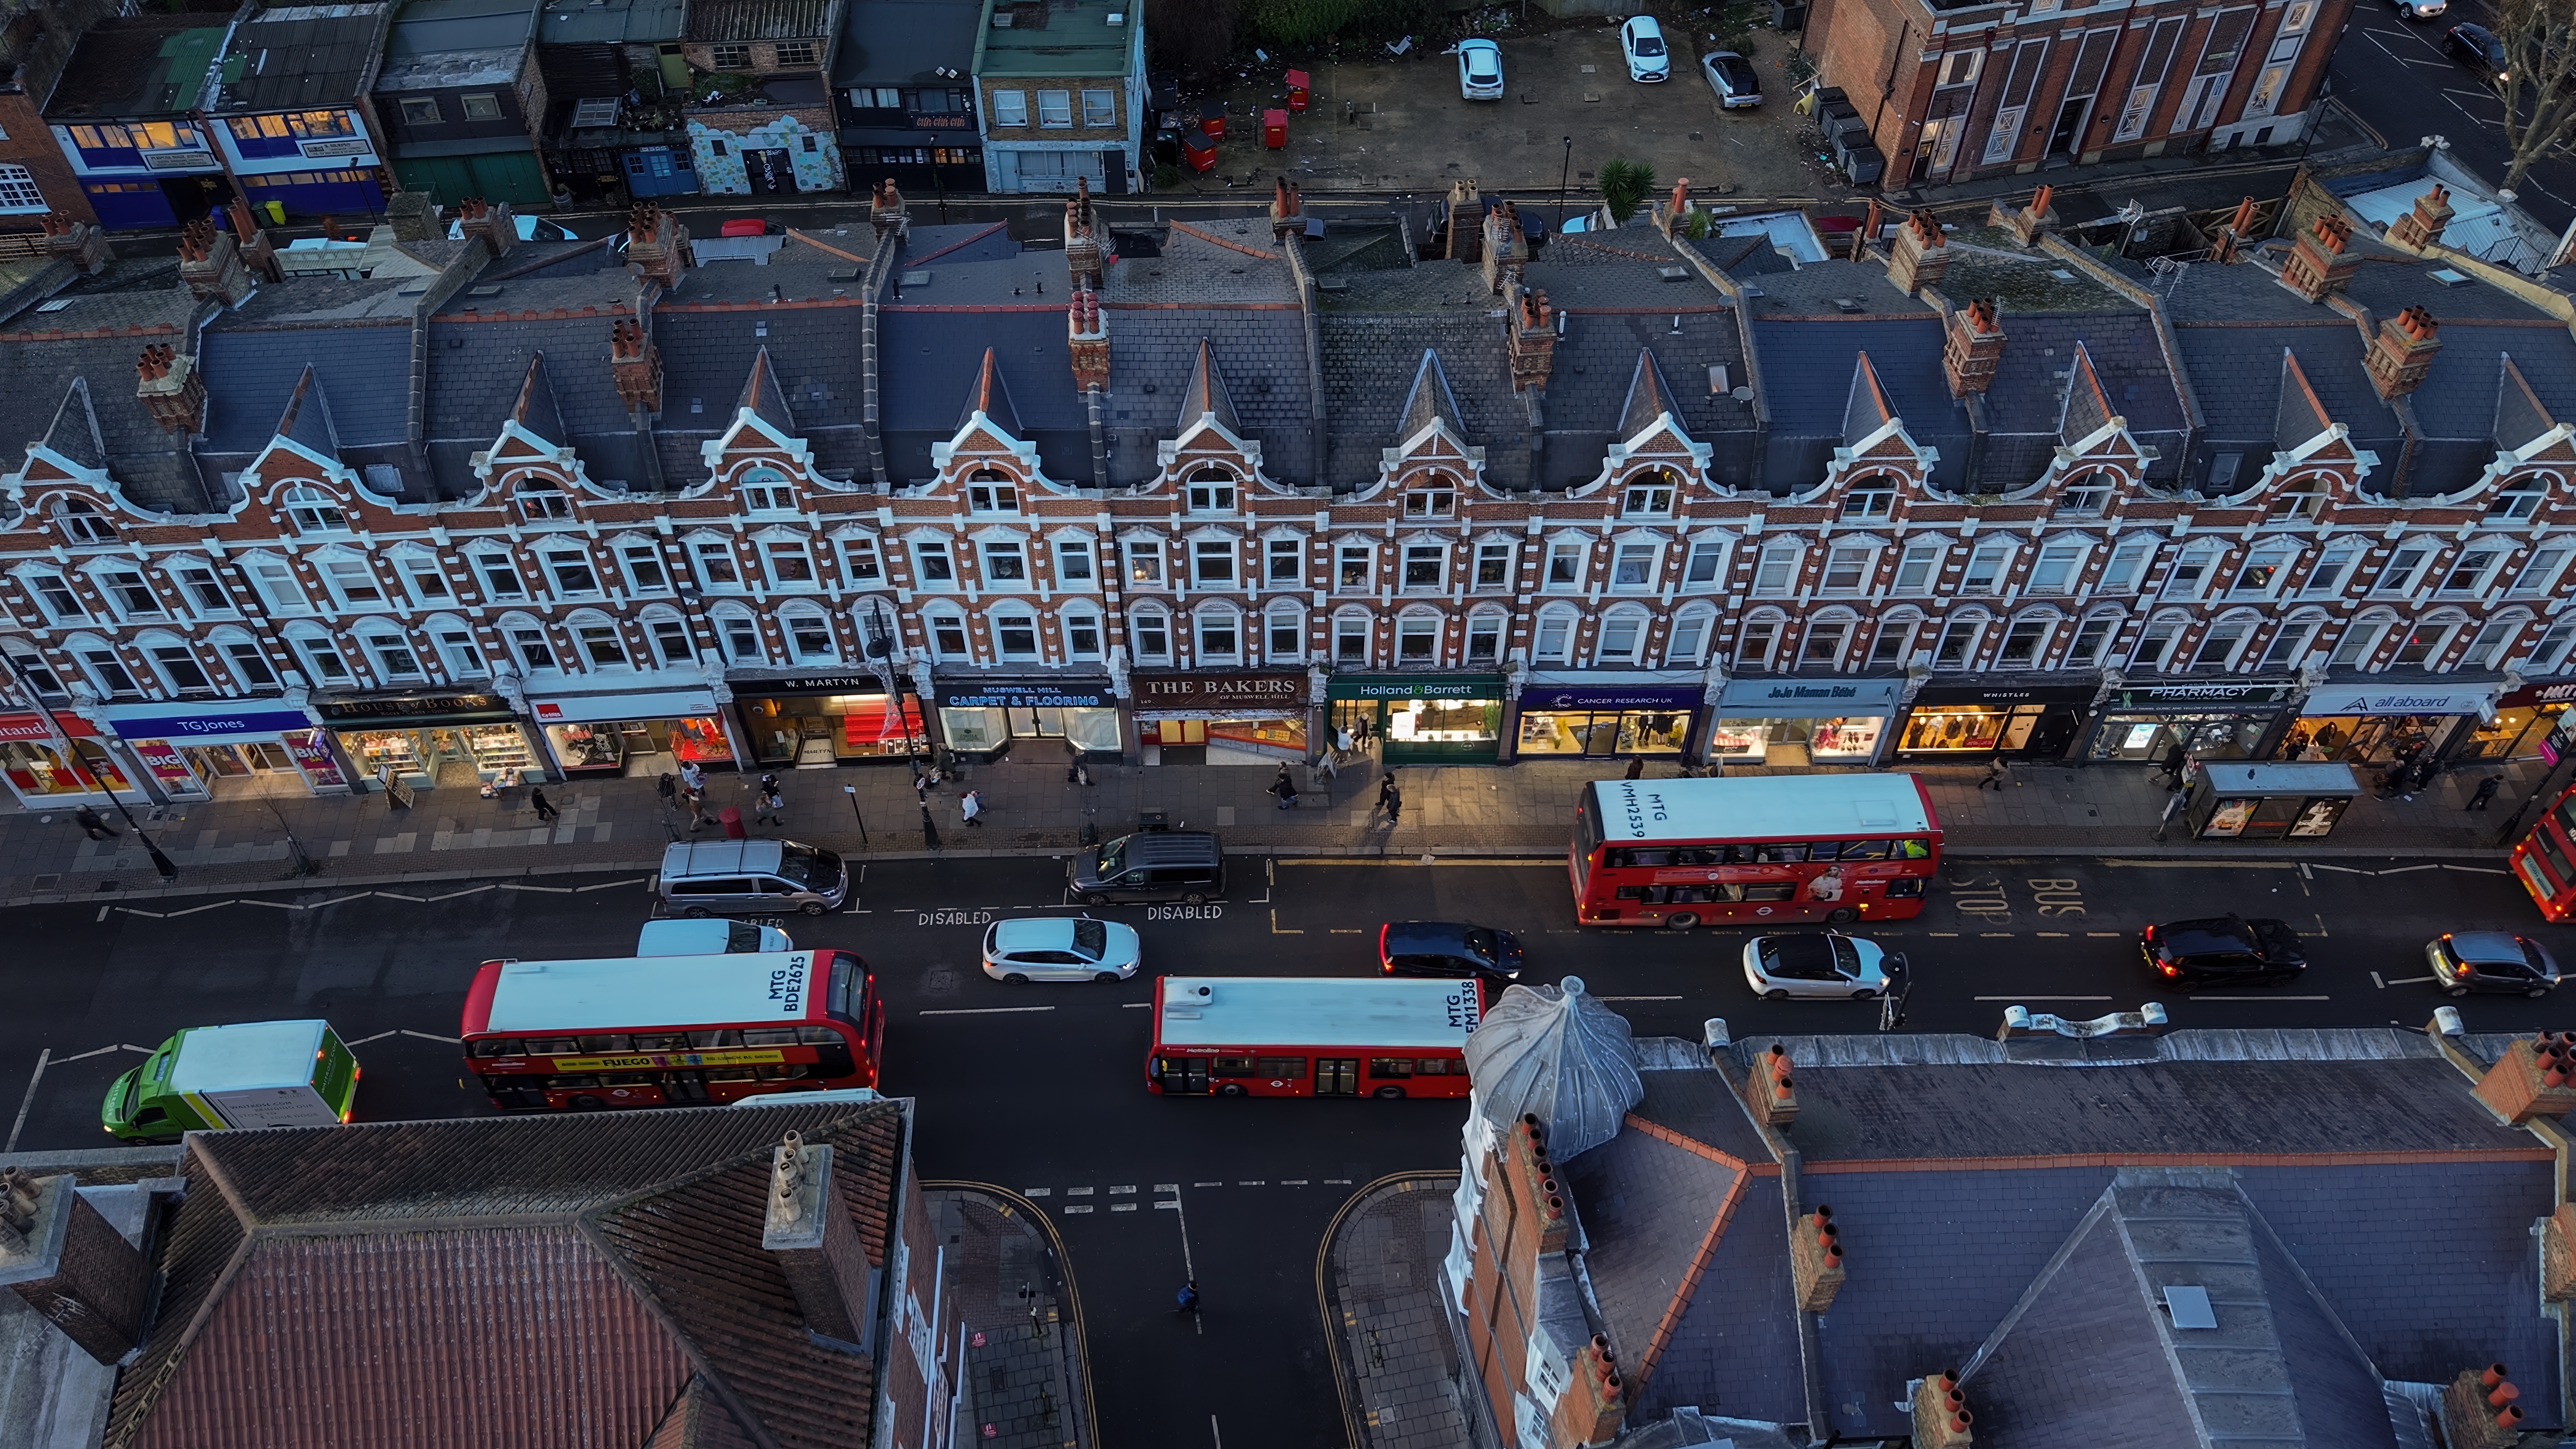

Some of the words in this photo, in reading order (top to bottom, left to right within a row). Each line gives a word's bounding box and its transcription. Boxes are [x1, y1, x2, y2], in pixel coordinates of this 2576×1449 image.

[805, 678, 859, 686] MARTYN
[1146, 681, 1194, 694] THE
[1203, 680, 1295, 693] BAKERS
[1768, 686, 1793, 698] JoJo
[1793, 686, 1831, 698] Maman
[1832, 686, 1857, 698] Bébé
[2149, 687, 2253, 697] PHARMACY
[950, 696, 1006, 706] CARPET
[1011, 696, 1022, 706] &
[1026, 696, 1099, 706] FLOORING
[177, 720, 245, 732] TGJones
[145, 754, 181, 766] BIG
[1620, 781, 1645, 837] VMH2539
[1647, 794, 1667, 821] MTG
[1948, 876, 2012, 925] STOP
[2027, 878, 2086, 918] BUS
[919, 911, 991, 925] DISABLED
[1148, 905, 1222, 920] DISABLED
[768, 970, 786, 1000] MTG
[783, 956, 805, 1012] BDE2625
[1446, 995, 1462, 1027] MTG
[602, 1057, 650, 1067] FUEGO
